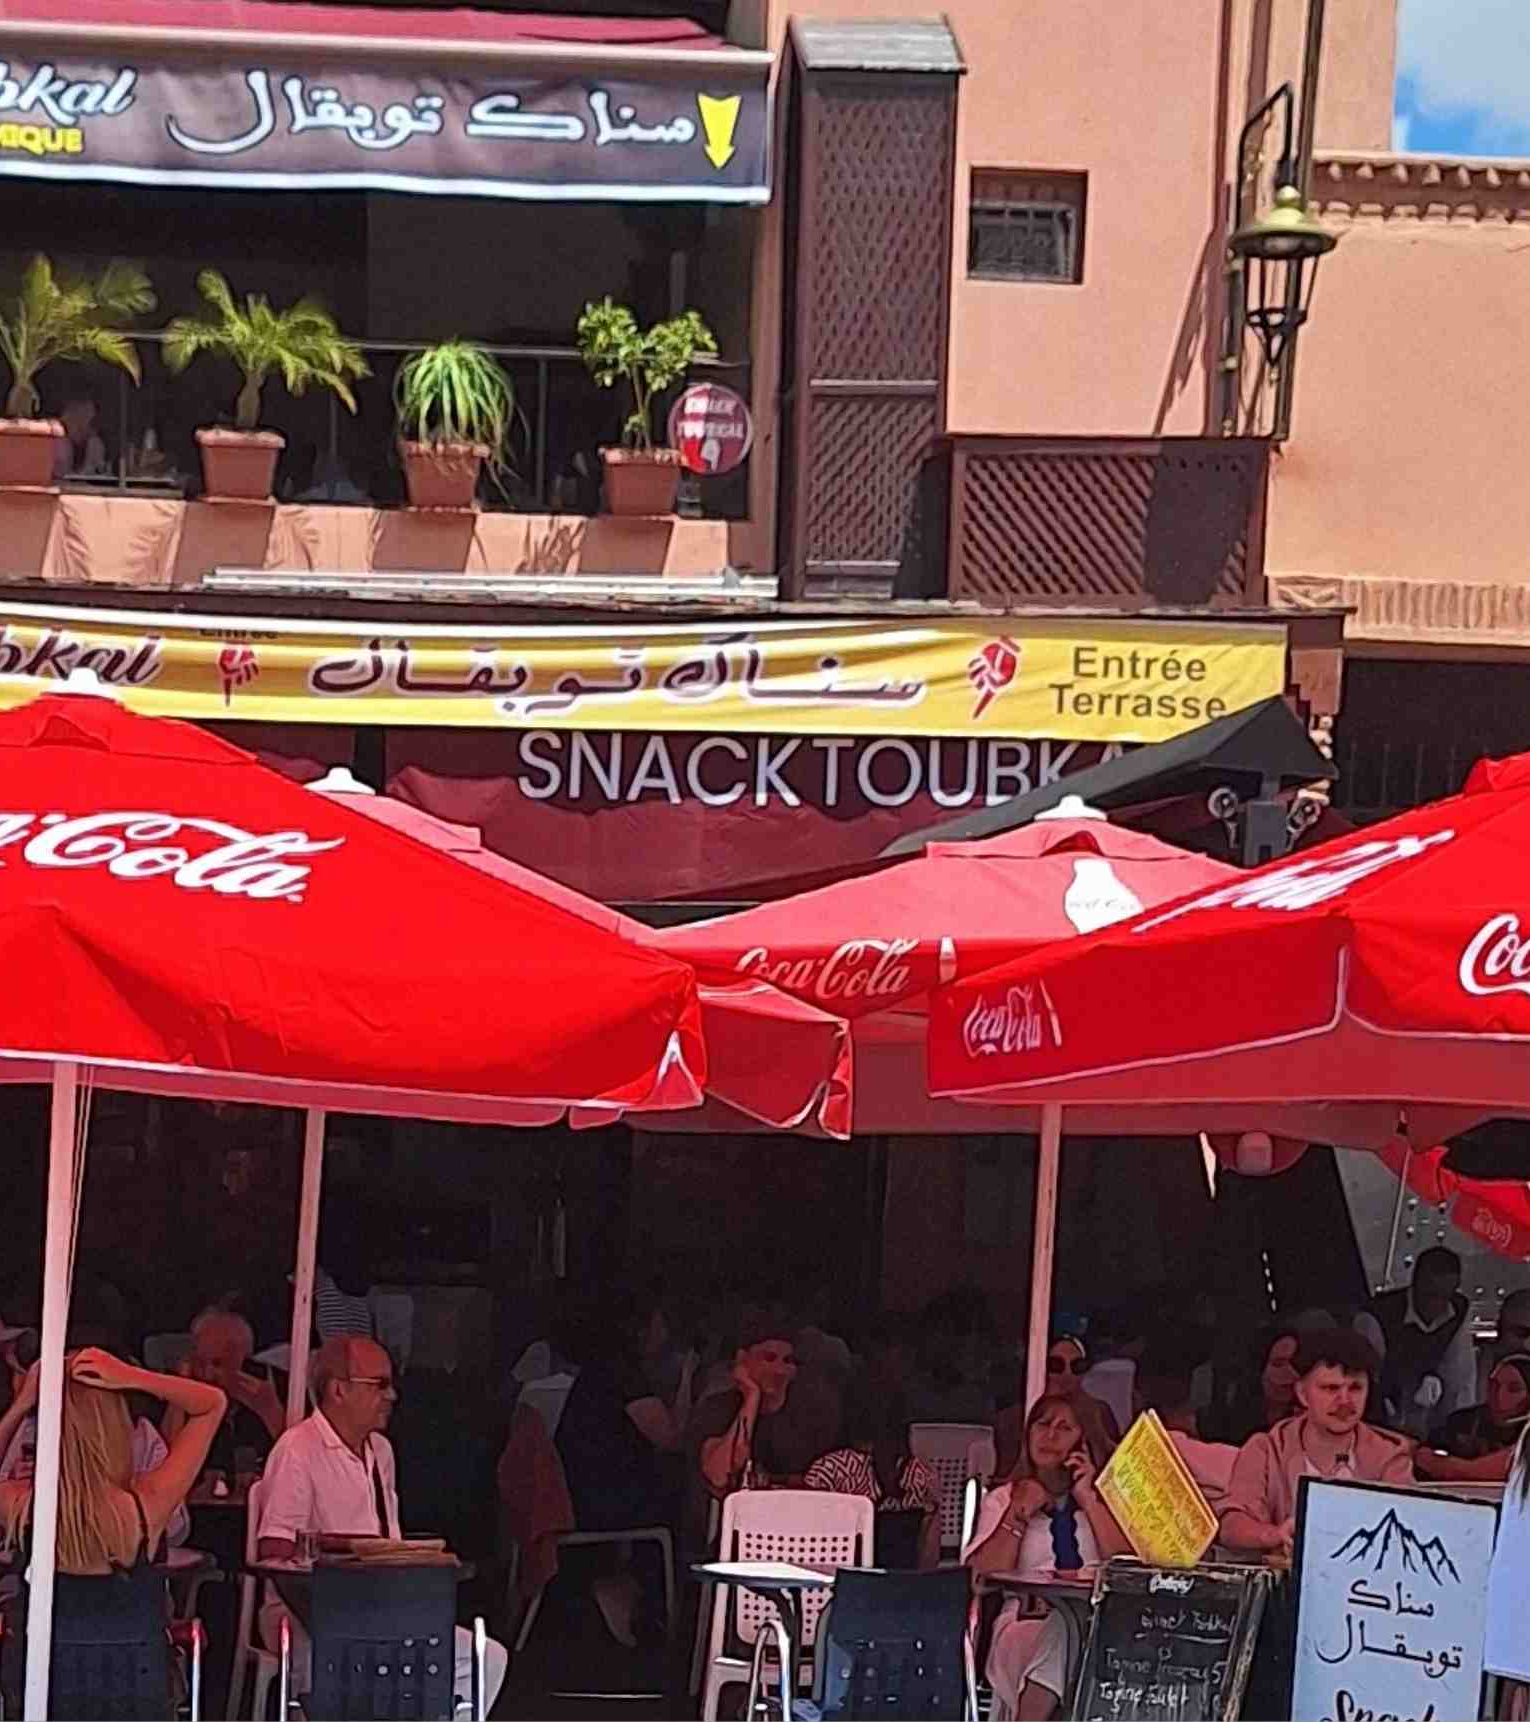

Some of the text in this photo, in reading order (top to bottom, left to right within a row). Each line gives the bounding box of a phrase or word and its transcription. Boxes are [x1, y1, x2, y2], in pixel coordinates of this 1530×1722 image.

[168, 70, 696, 154] سناك توبقال
[662, 631, 928, 703] سناك
[1072, 646, 1207, 681] Entrée
[1049, 683, 1227, 720] Terrasse
[1347, 1579, 1435, 1617] سناك
[1314, 1613, 1463, 1678] توبقال
